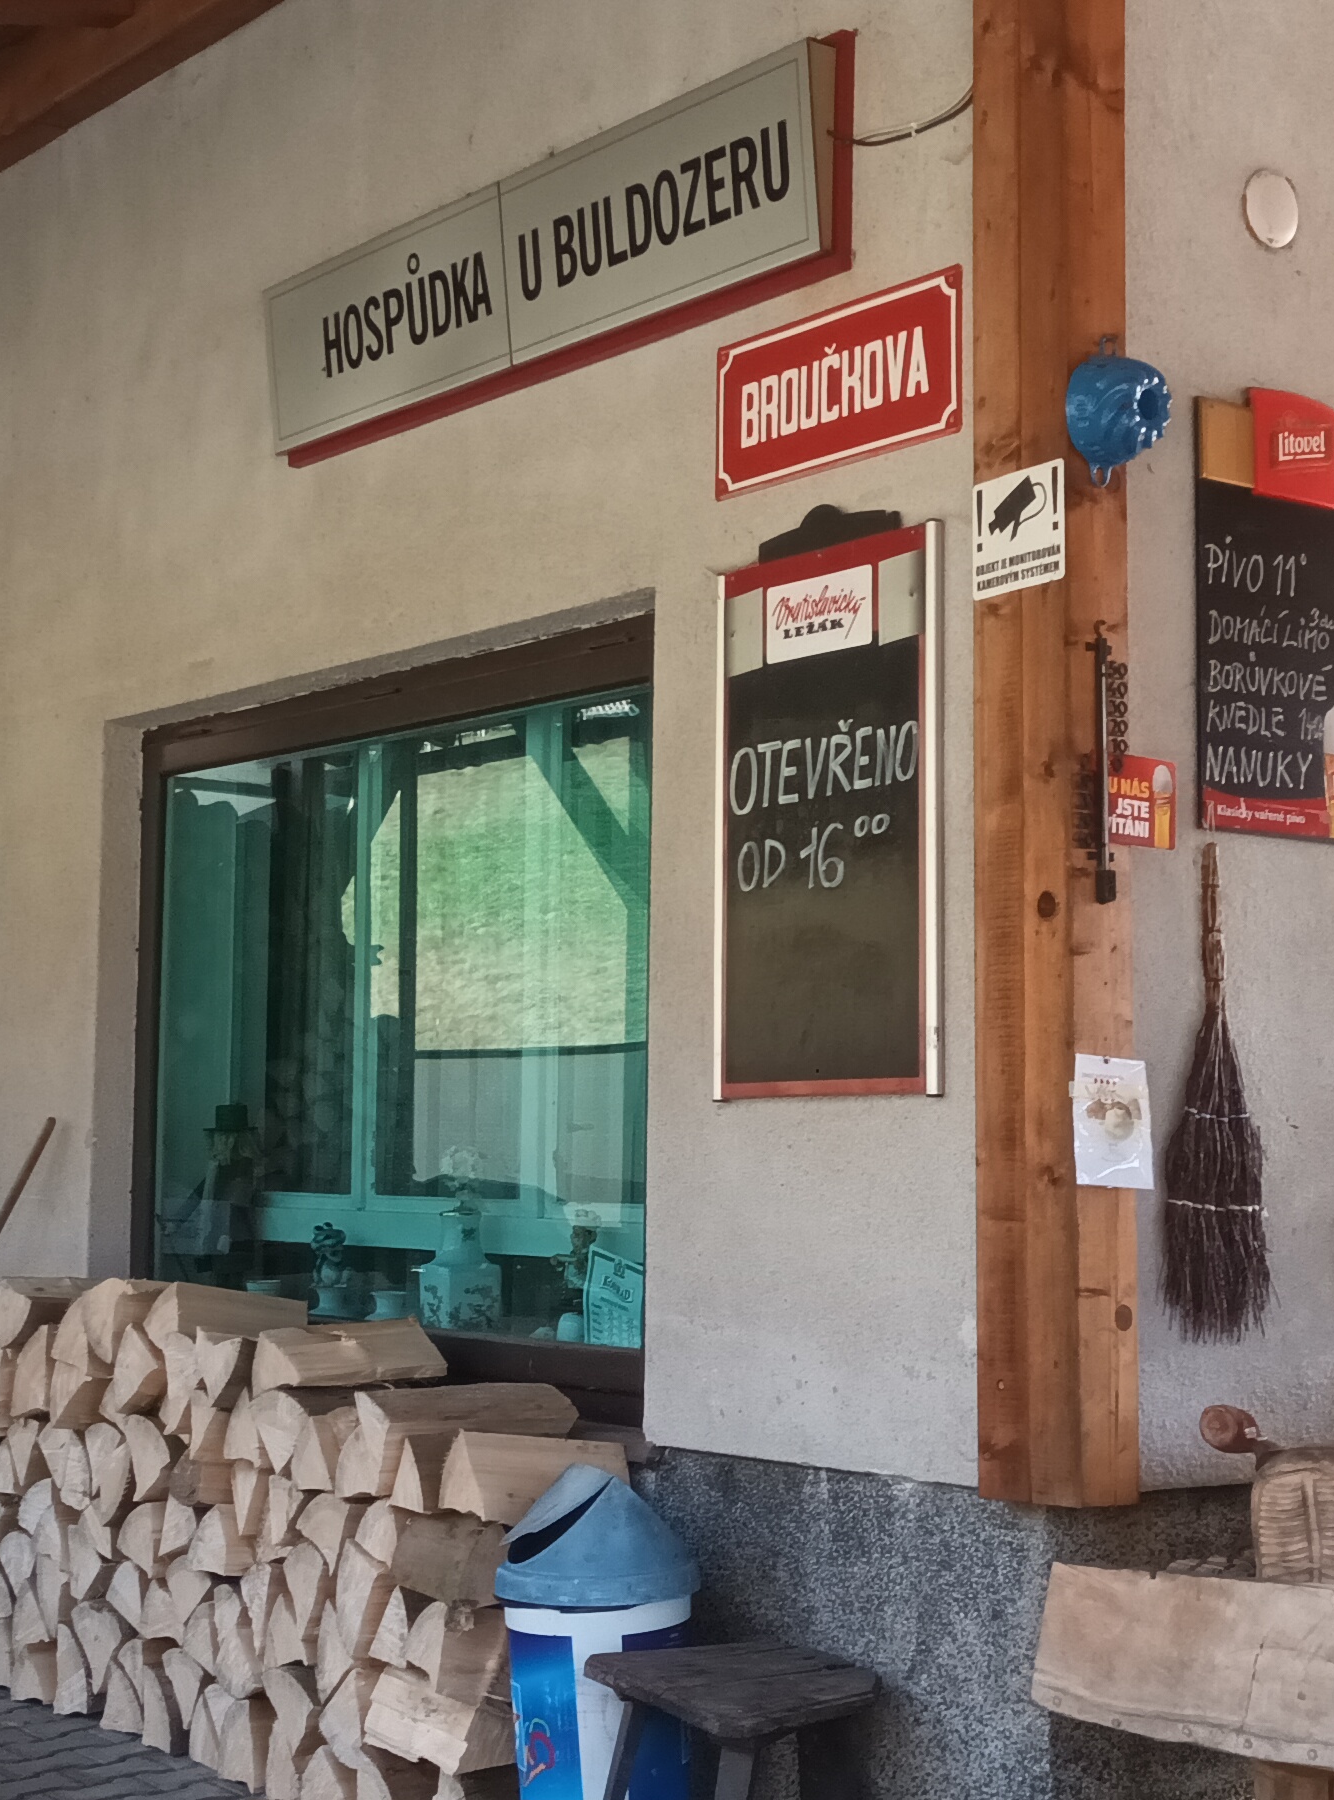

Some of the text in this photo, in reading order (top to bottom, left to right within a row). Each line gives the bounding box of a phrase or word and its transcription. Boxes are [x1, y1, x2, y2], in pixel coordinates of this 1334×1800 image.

[322, 118, 791, 378] HOSPŮDKA U BULDOZERU
[740, 325, 930, 449] BROUČKOVA
[1278, 430, 1326, 461] Litovel
[976, 561, 1000, 577] OBJEKT
[1008, 543, 1061, 568] MONITOROVÁN
[783, 617, 845, 640] LEŽÁK
[1208, 604, 1290, 646] DOMÁCÍ
[1207, 651, 1333, 701] BORŮVKOVÉ
[729, 719, 919, 816] OTEVŘENO
[1121, 777, 1150, 798] NÁS
[1205, 743, 1313, 790] NANUKY
[1116, 797, 1150, 818] JSTE
[737, 838, 787, 892] OD
